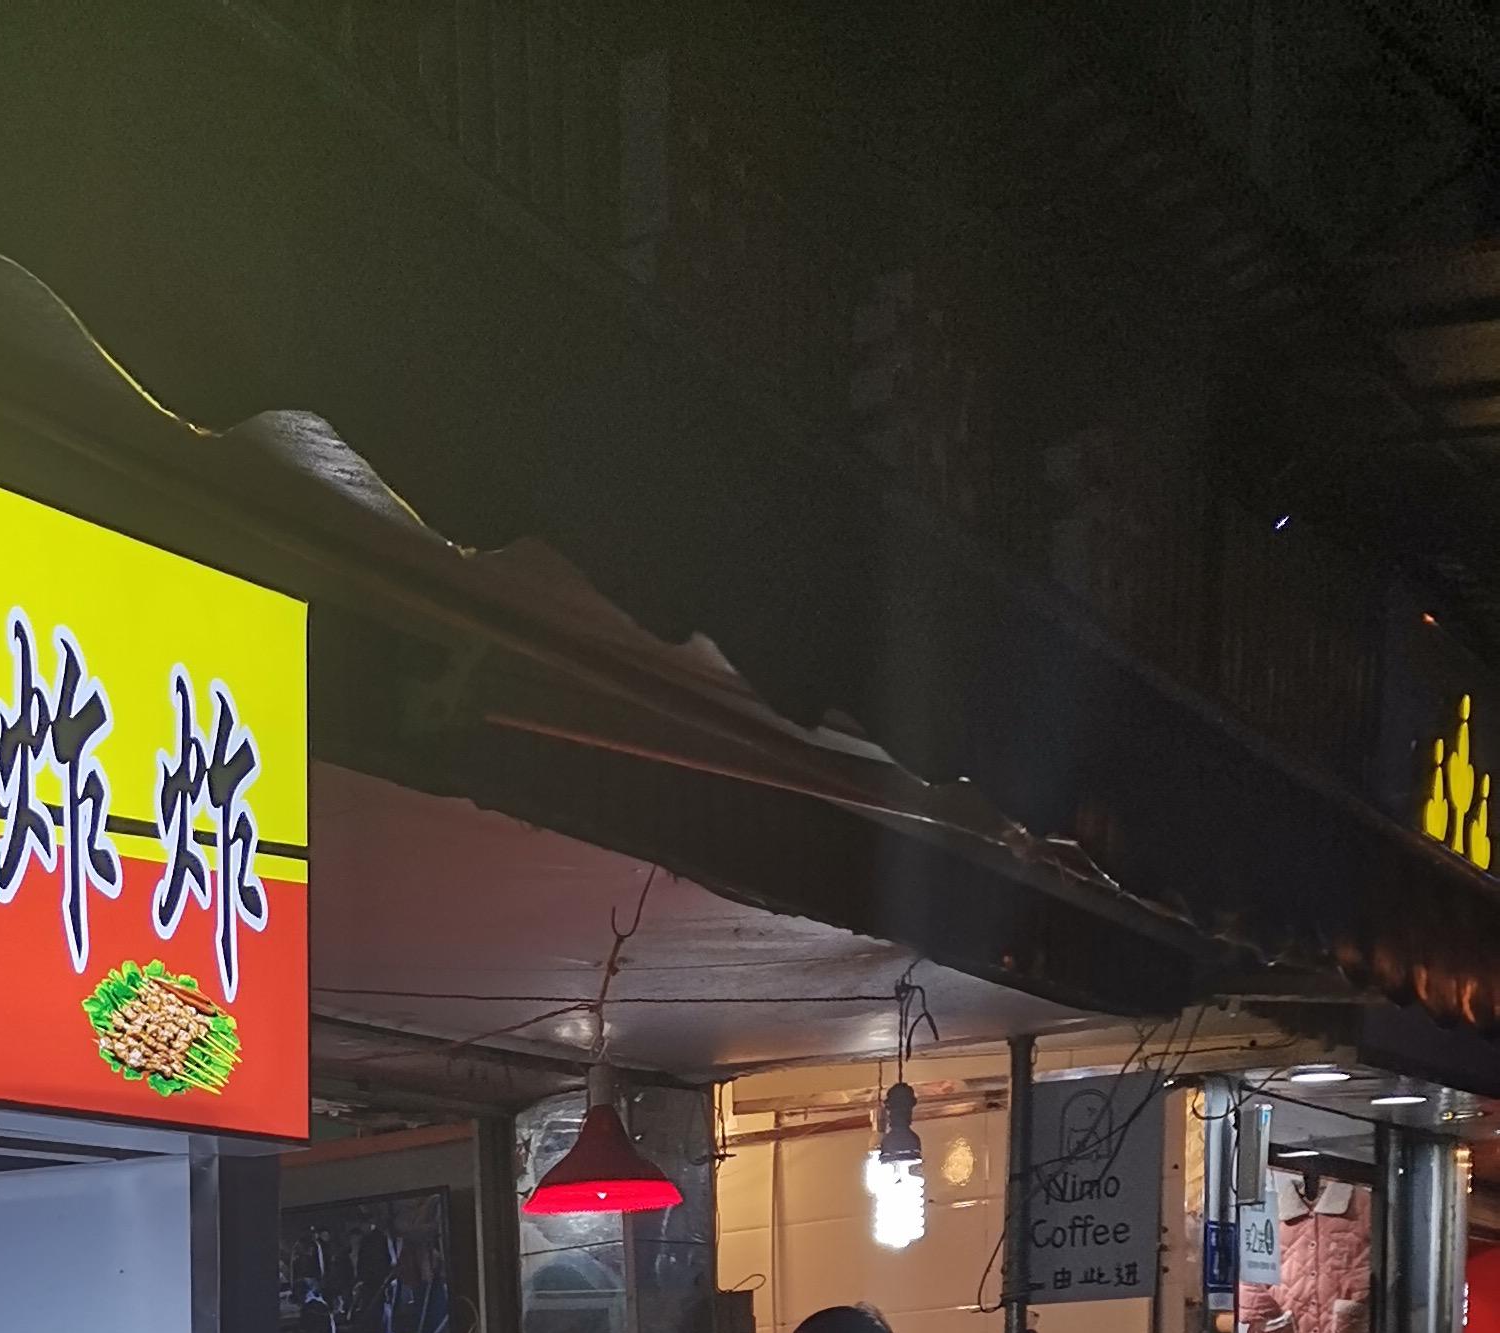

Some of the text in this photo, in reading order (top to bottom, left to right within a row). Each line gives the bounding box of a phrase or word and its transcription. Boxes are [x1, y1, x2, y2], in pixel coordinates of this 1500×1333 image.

[1045, 1172, 1121, 1204] Nimo
[1031, 1215, 1131, 1249] Coffee
[1052, 1263, 1140, 1290] 由此进
